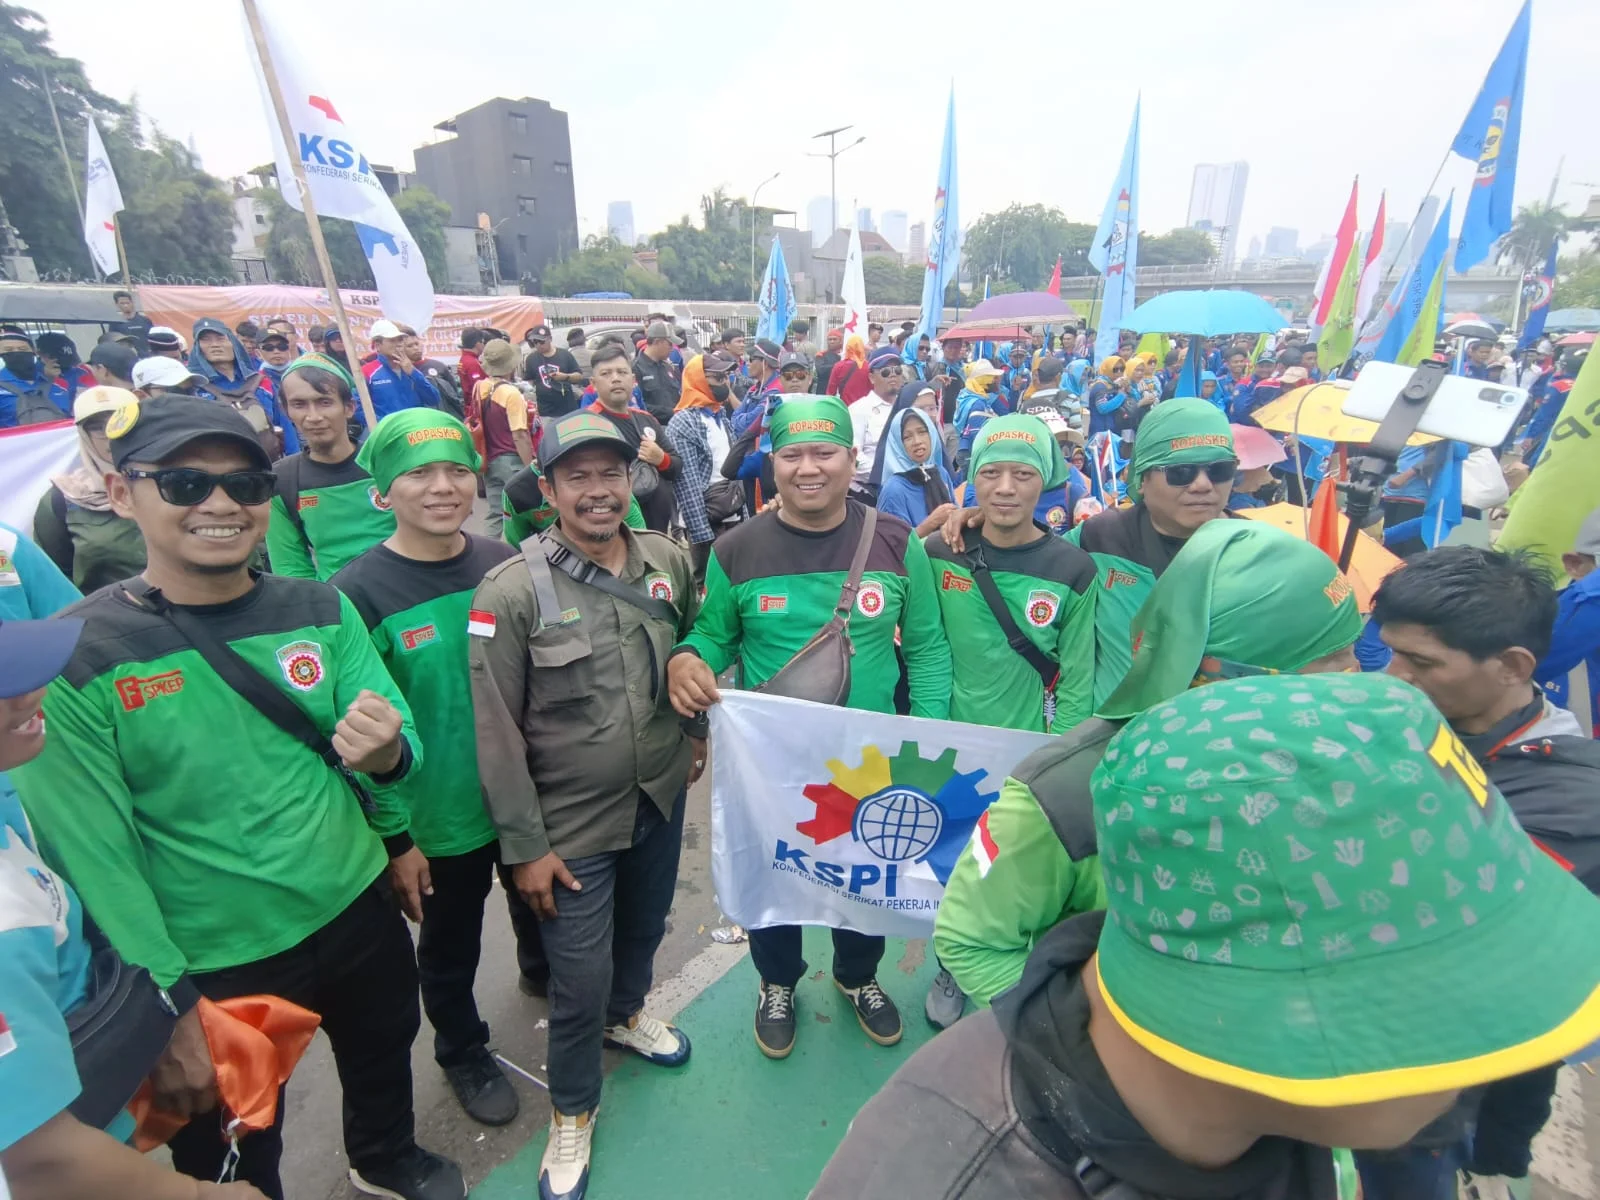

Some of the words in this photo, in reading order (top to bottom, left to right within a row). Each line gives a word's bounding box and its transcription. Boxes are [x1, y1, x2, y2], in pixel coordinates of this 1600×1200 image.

[303, 163, 350, 181] KONFEDERASI
[788, 419, 835, 434] KOPASKEP
[143, 676, 185, 700] SPKEP
[774, 838, 898, 898] KSPI
[772, 860, 839, 896] KONFEDERASI
[841, 891, 883, 909] SERIKAT
[886, 898, 931, 911] PEKERJA
